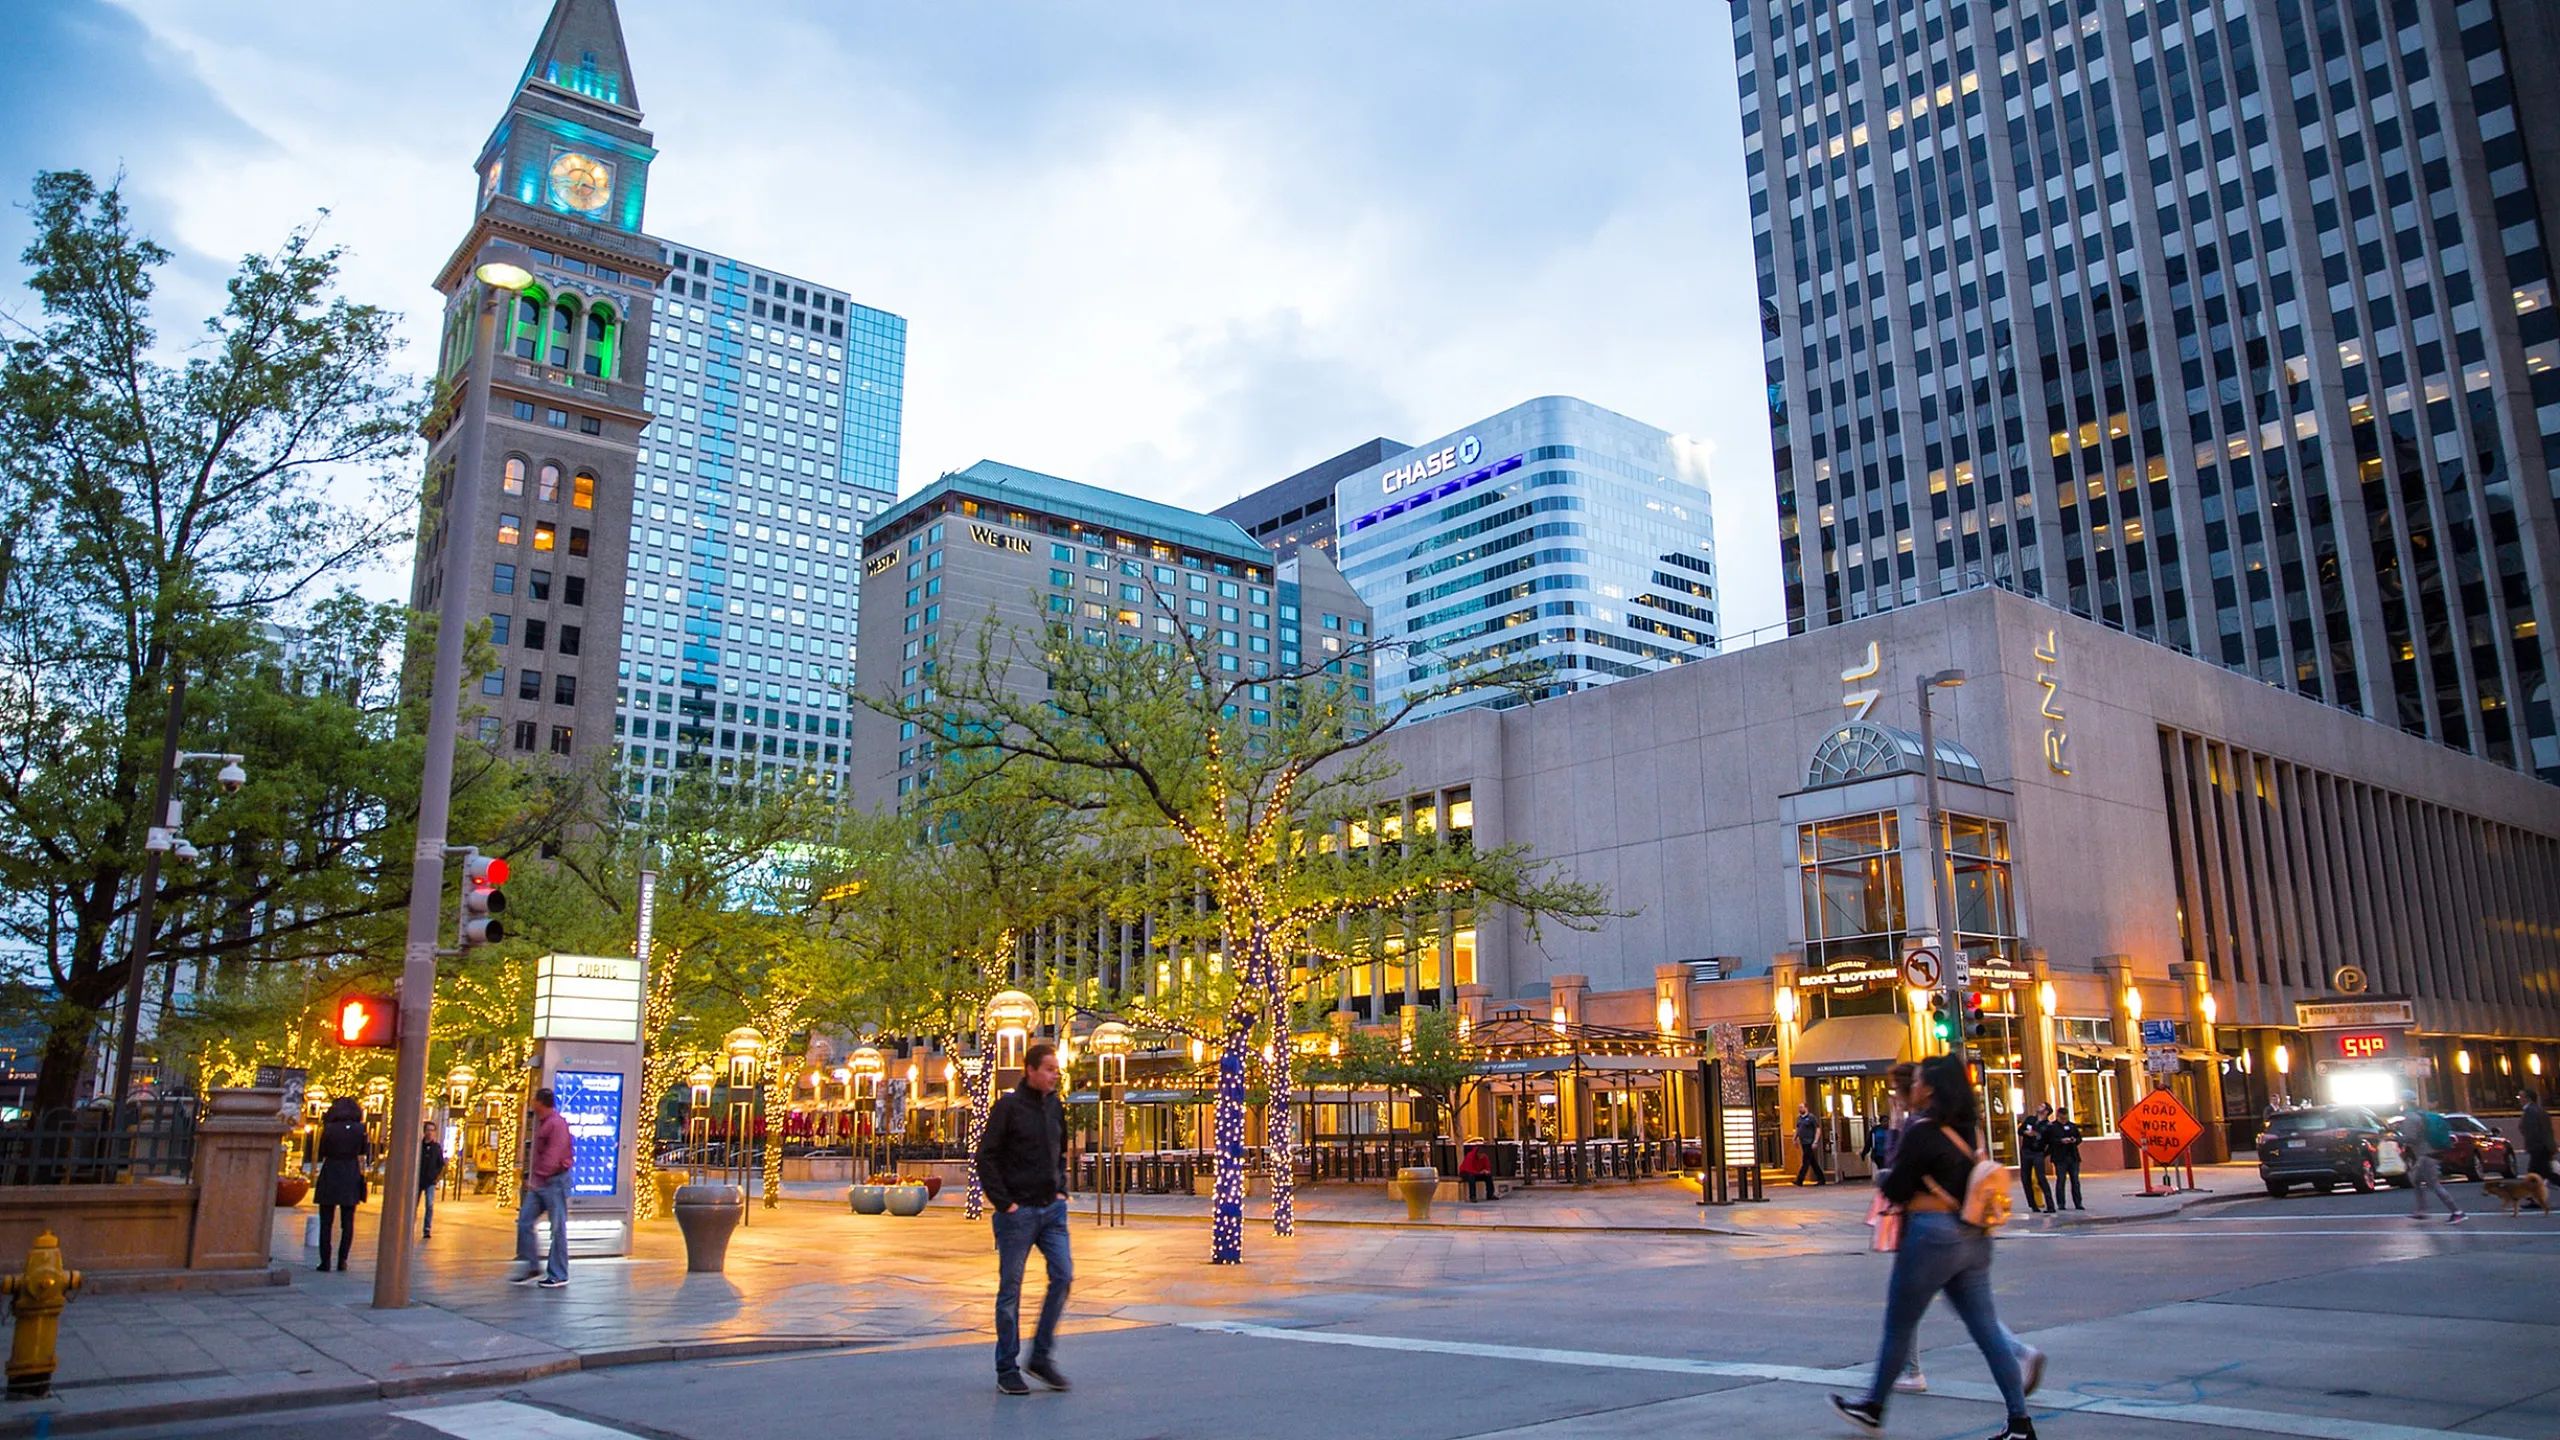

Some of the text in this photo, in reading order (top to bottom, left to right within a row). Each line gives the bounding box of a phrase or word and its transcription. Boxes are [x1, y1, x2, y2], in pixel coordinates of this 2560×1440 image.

[1382, 446, 1456, 494] CHASE
[969, 524, 1032, 554] WESTIN
[640, 883, 654, 958] INFORMATION
[1956, 953, 1967, 962] ONE
[577, 962, 619, 979] CURTIS
[1799, 968, 1898, 986] ROCK BOTTOM
[2343, 971, 2359, 989] P
[2142, 1104, 2176, 1115] ROAD
[2142, 1120, 2176, 1132] WORK
